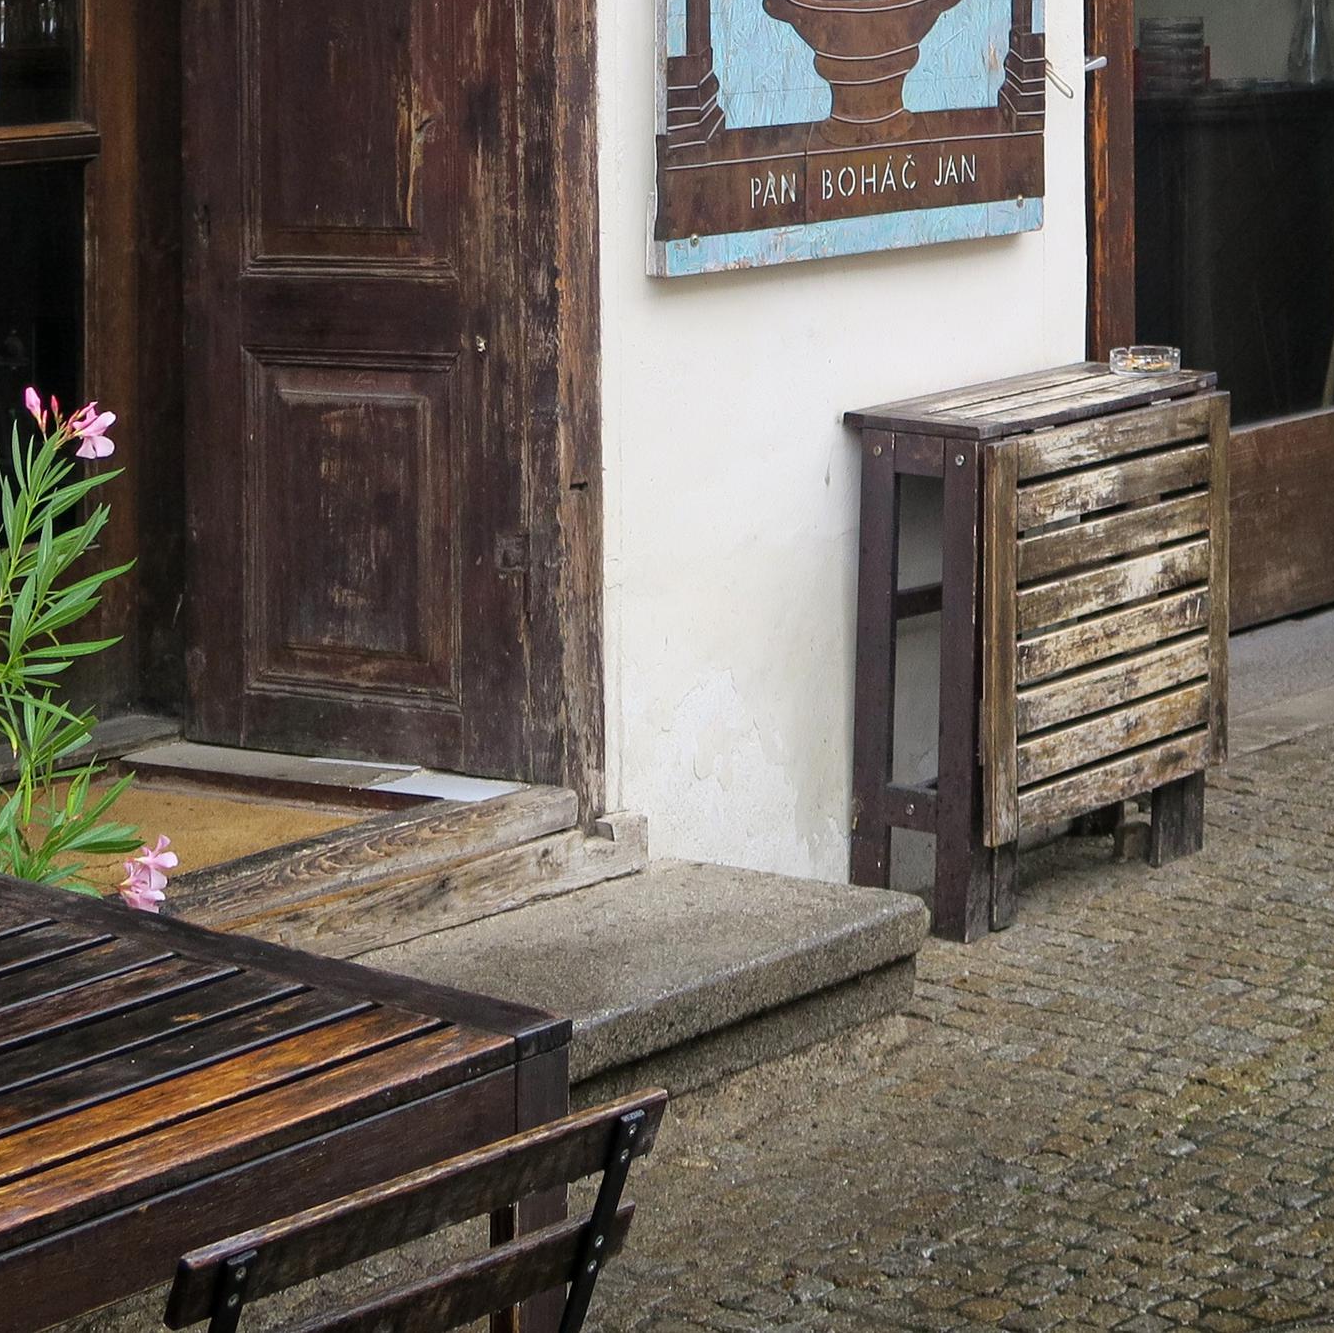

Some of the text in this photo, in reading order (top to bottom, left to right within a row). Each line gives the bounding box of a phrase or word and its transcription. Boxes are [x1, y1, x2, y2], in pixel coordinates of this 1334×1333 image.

[750, 153, 976, 209] PAN BOHÁČ JAN
